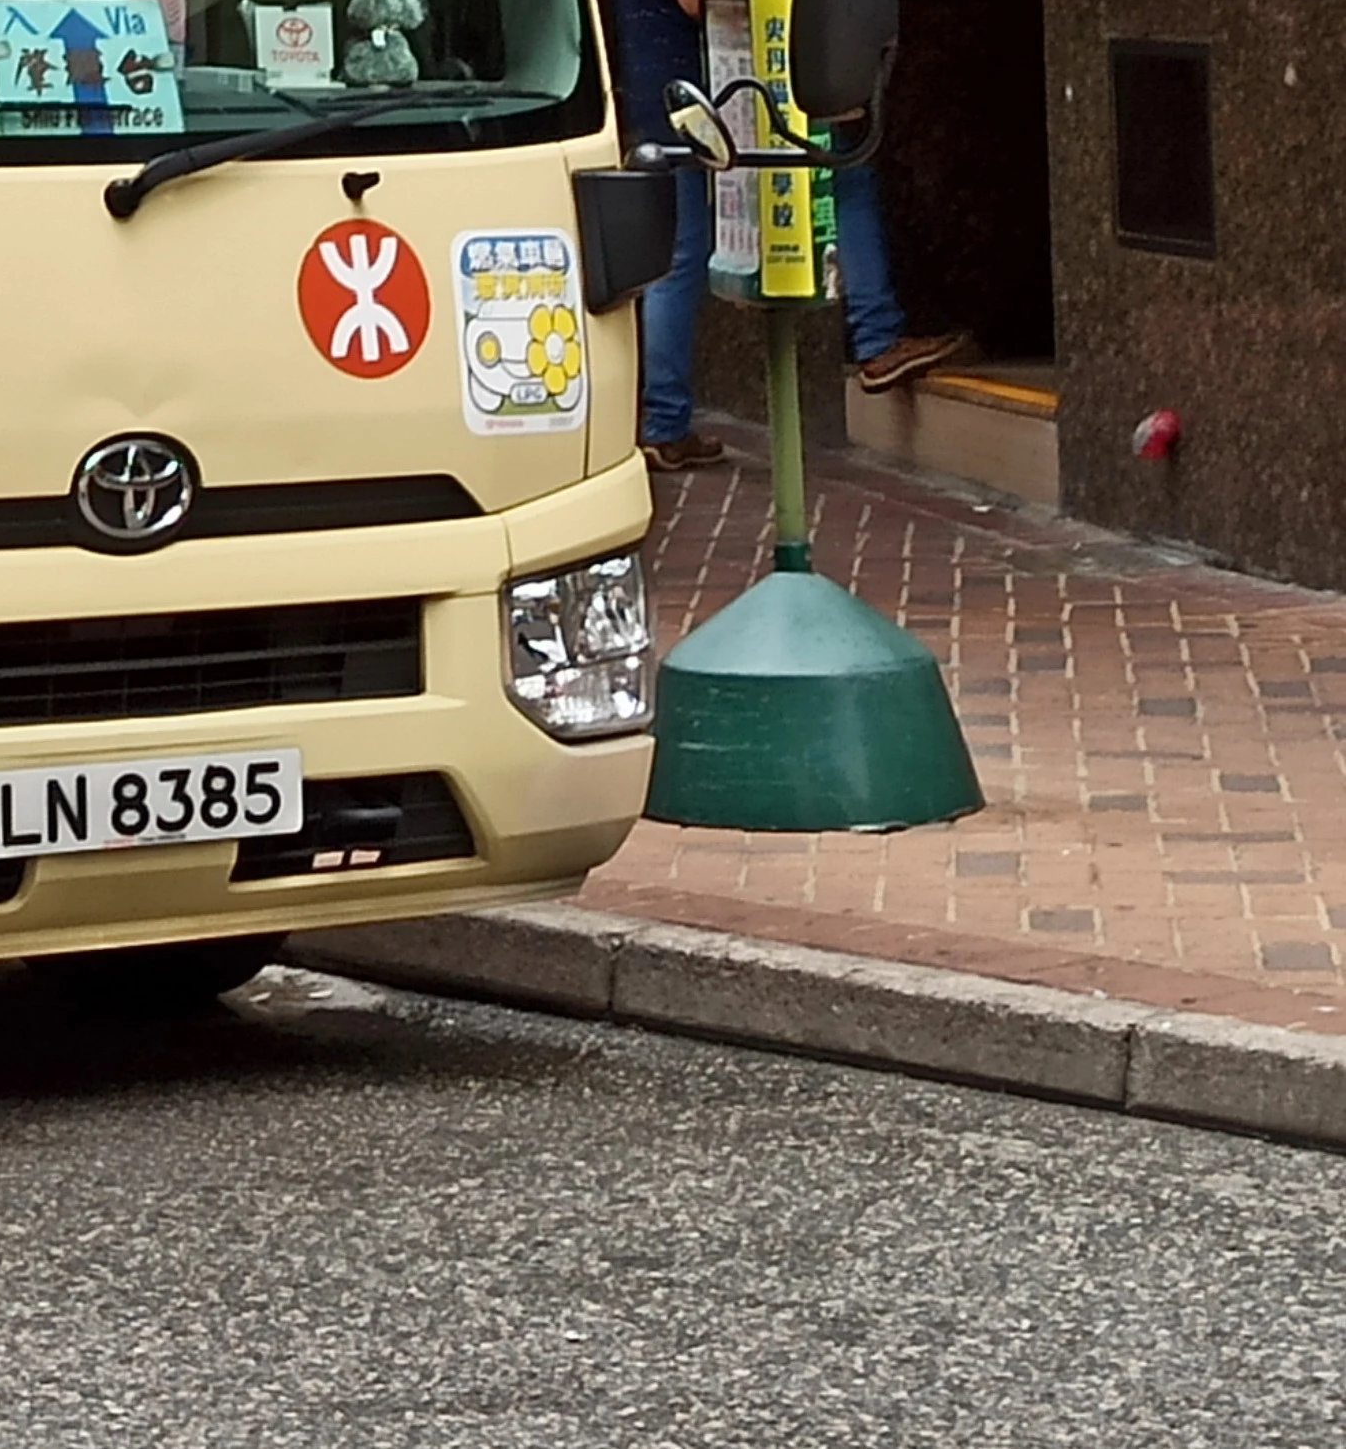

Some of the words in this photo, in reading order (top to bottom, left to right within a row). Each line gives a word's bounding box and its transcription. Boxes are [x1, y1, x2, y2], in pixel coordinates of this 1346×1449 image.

[104, 5, 147, 36] Via
[1, 774, 88, 848] LN
[111, 760, 282, 837] 8385
